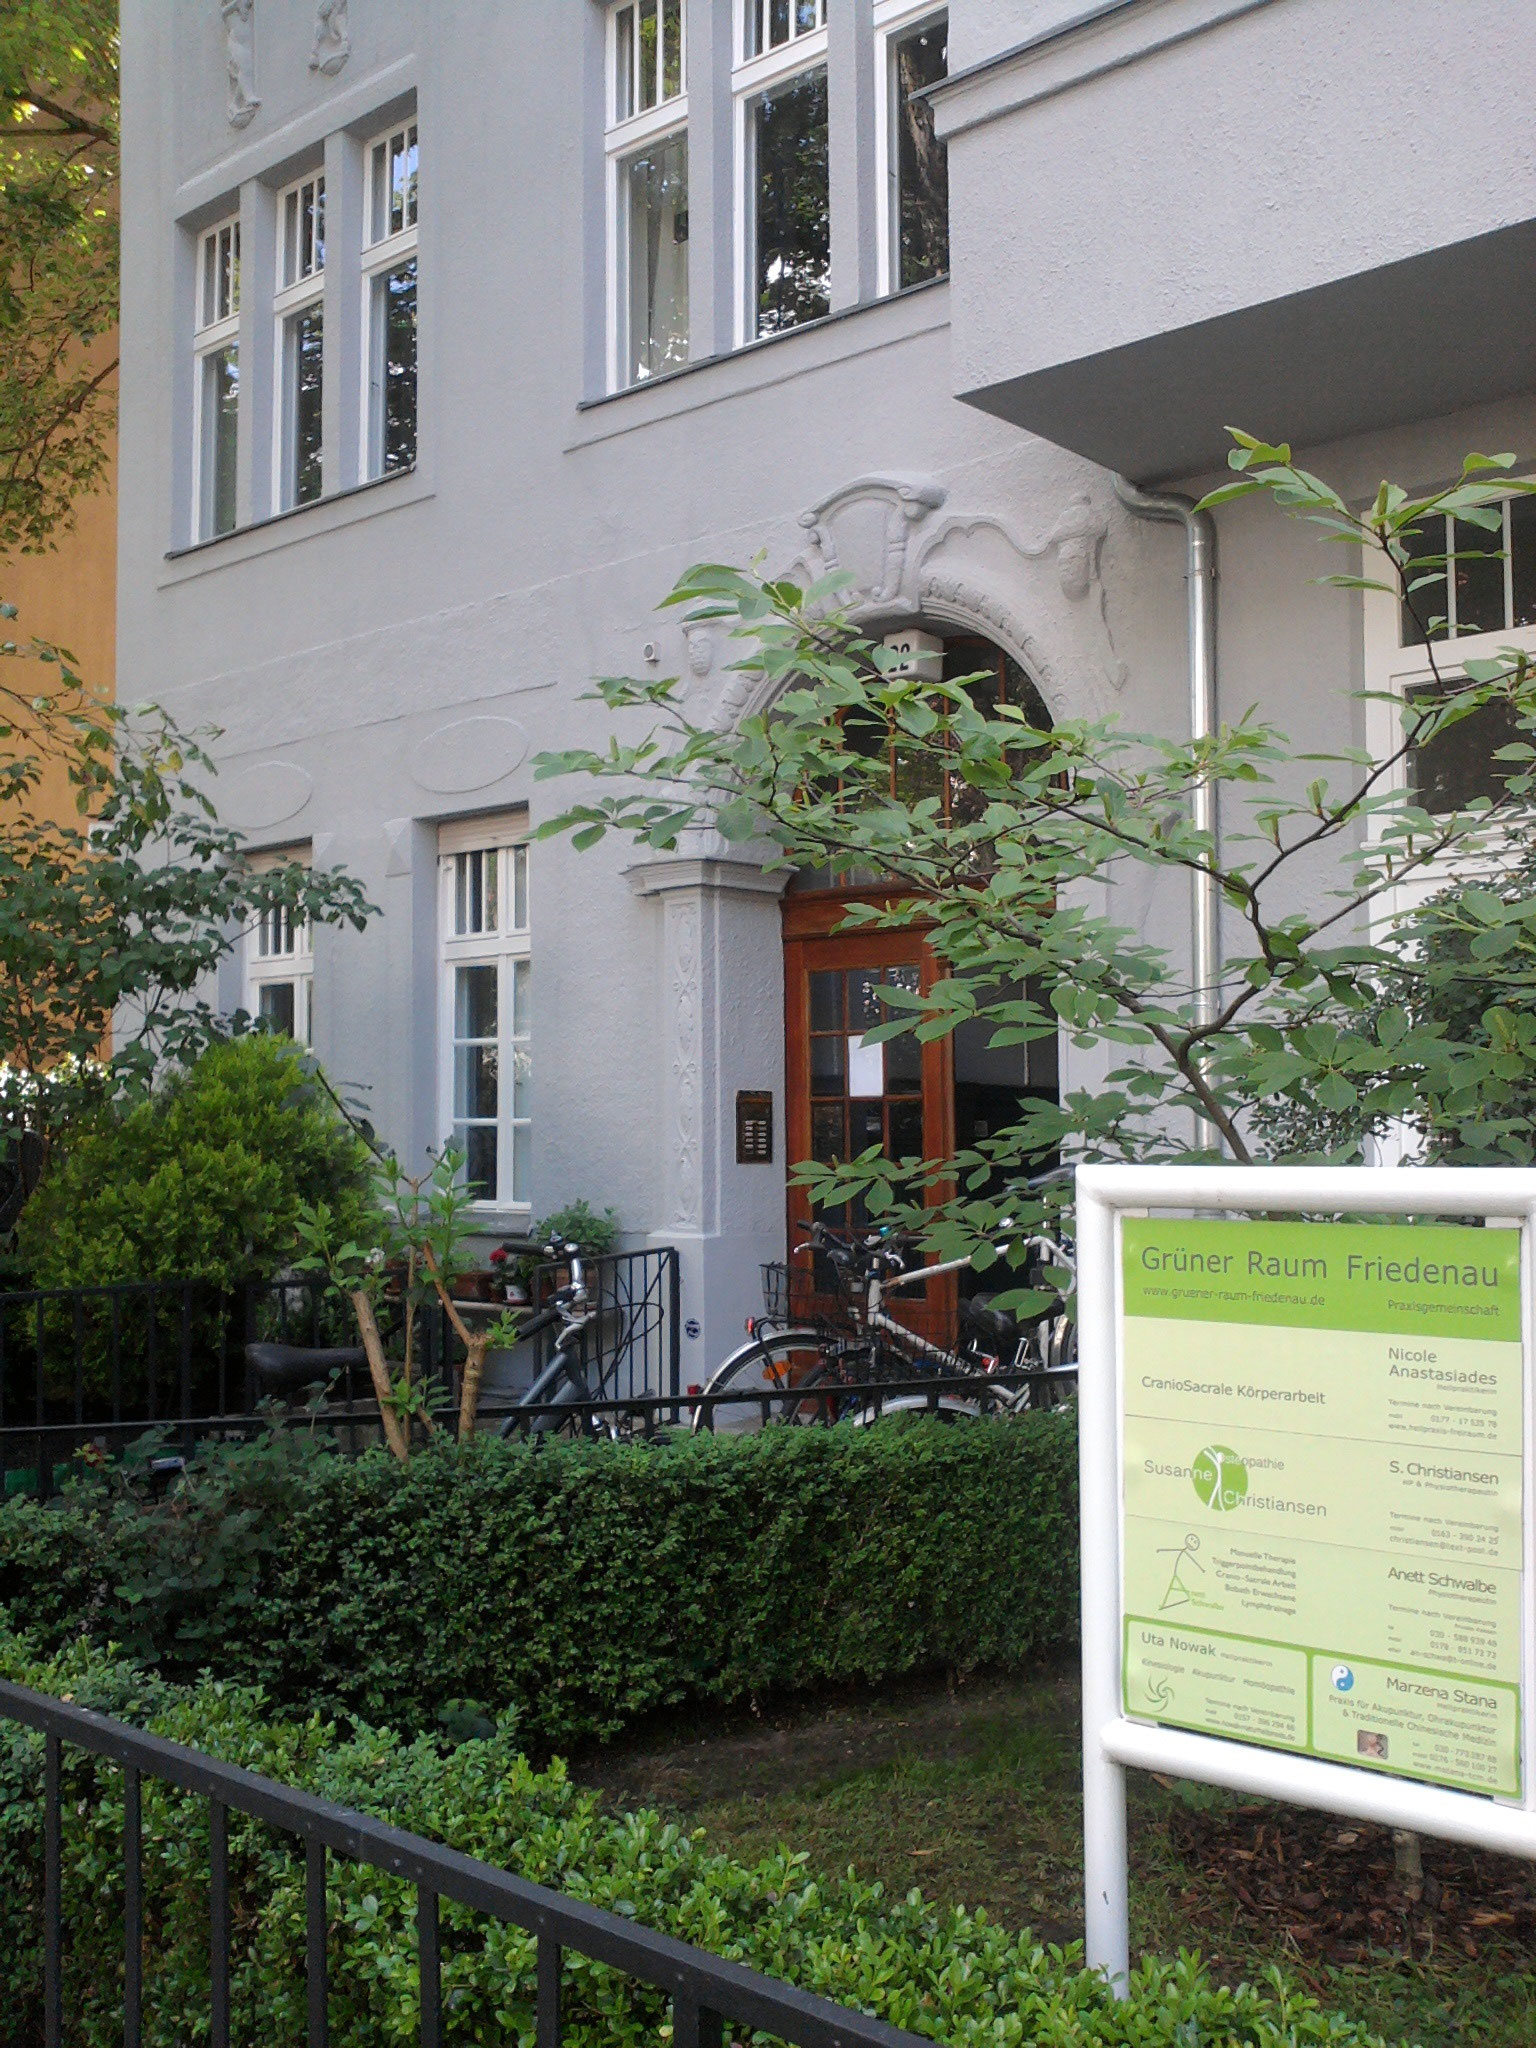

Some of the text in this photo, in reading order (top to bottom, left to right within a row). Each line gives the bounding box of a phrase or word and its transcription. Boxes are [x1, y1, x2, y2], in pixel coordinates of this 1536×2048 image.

[1141, 1246, 1499, 1287] Grüner Raum Friedenau
[1142, 1286, 1326, 1306] www.gruener-raum-friedenau.de
[1387, 1299, 1500, 1317] Praxisgemeinschaft
[1388, 1347, 1437, 1363] Nicole
[1389, 1364, 1498, 1386] Anastasiades
[1141, 1375, 1326, 1405] CranioSacrale Körperarbeit
[1144, 1459, 1213, 1482] Susanne
[1389, 1460, 1499, 1485] S. Christiansen
[1223, 1490, 1327, 1517] Christiansen
[1388, 1566, 1497, 1595] Anett Schwalbe
[1141, 1631, 1217, 1657] Uta Nowak
[1387, 1676, 1498, 1710] Marzena Stana
